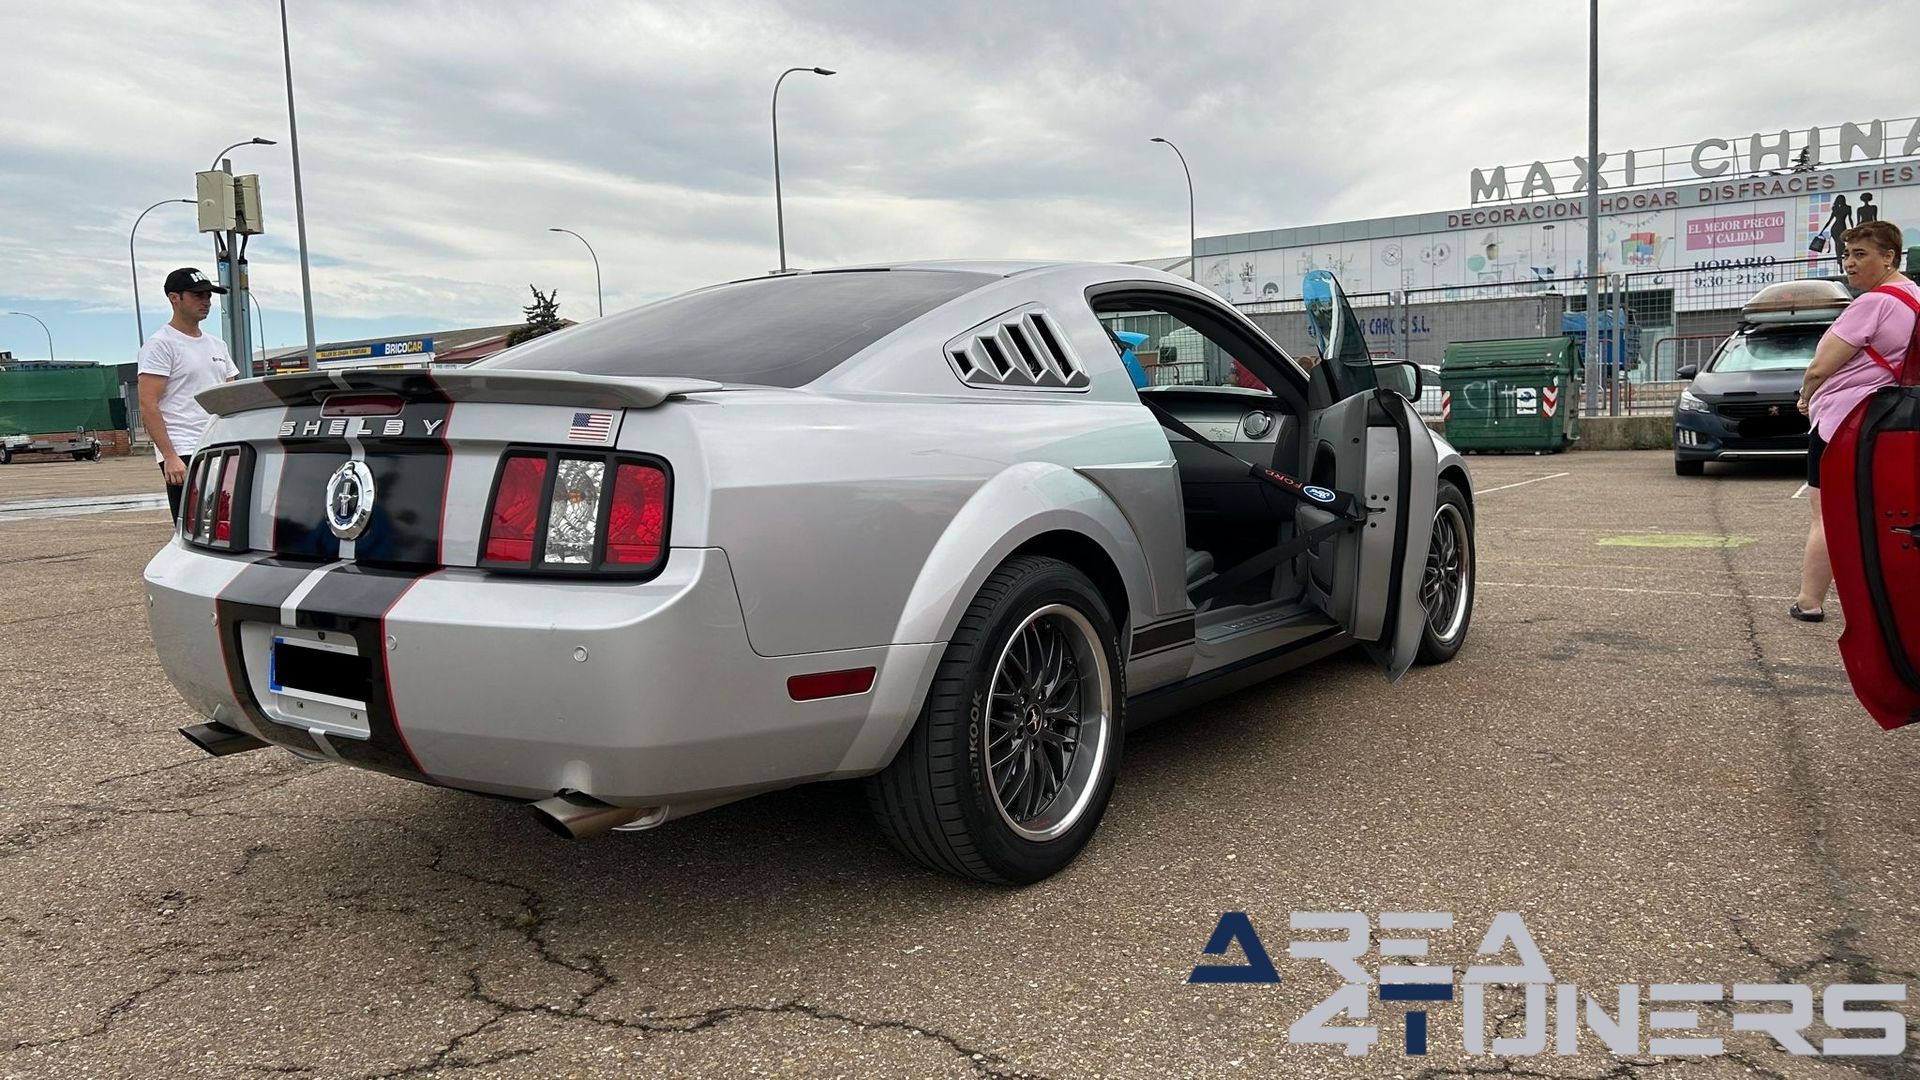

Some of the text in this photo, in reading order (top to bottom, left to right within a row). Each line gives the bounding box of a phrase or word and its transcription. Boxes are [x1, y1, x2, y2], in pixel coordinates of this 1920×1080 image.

[1470, 149, 1635, 203] MAXI
[1448, 165, 1920, 228] DECORACION HOGAR DISFRACES FIES
[1688, 215, 1784, 234] EL MEJOR PRECIO
[1706, 229, 1764, 245] Y CALIDAD
[1694, 255, 1776, 273] HORARIO
[1694, 275, 1724, 288] 9:30
[1736, 272, 1775, 285] 21:30
[385, 341, 423, 355] BRICOCAR
[279, 419, 444, 436] SHELBY
[1264, 469, 1303, 490] FORD
